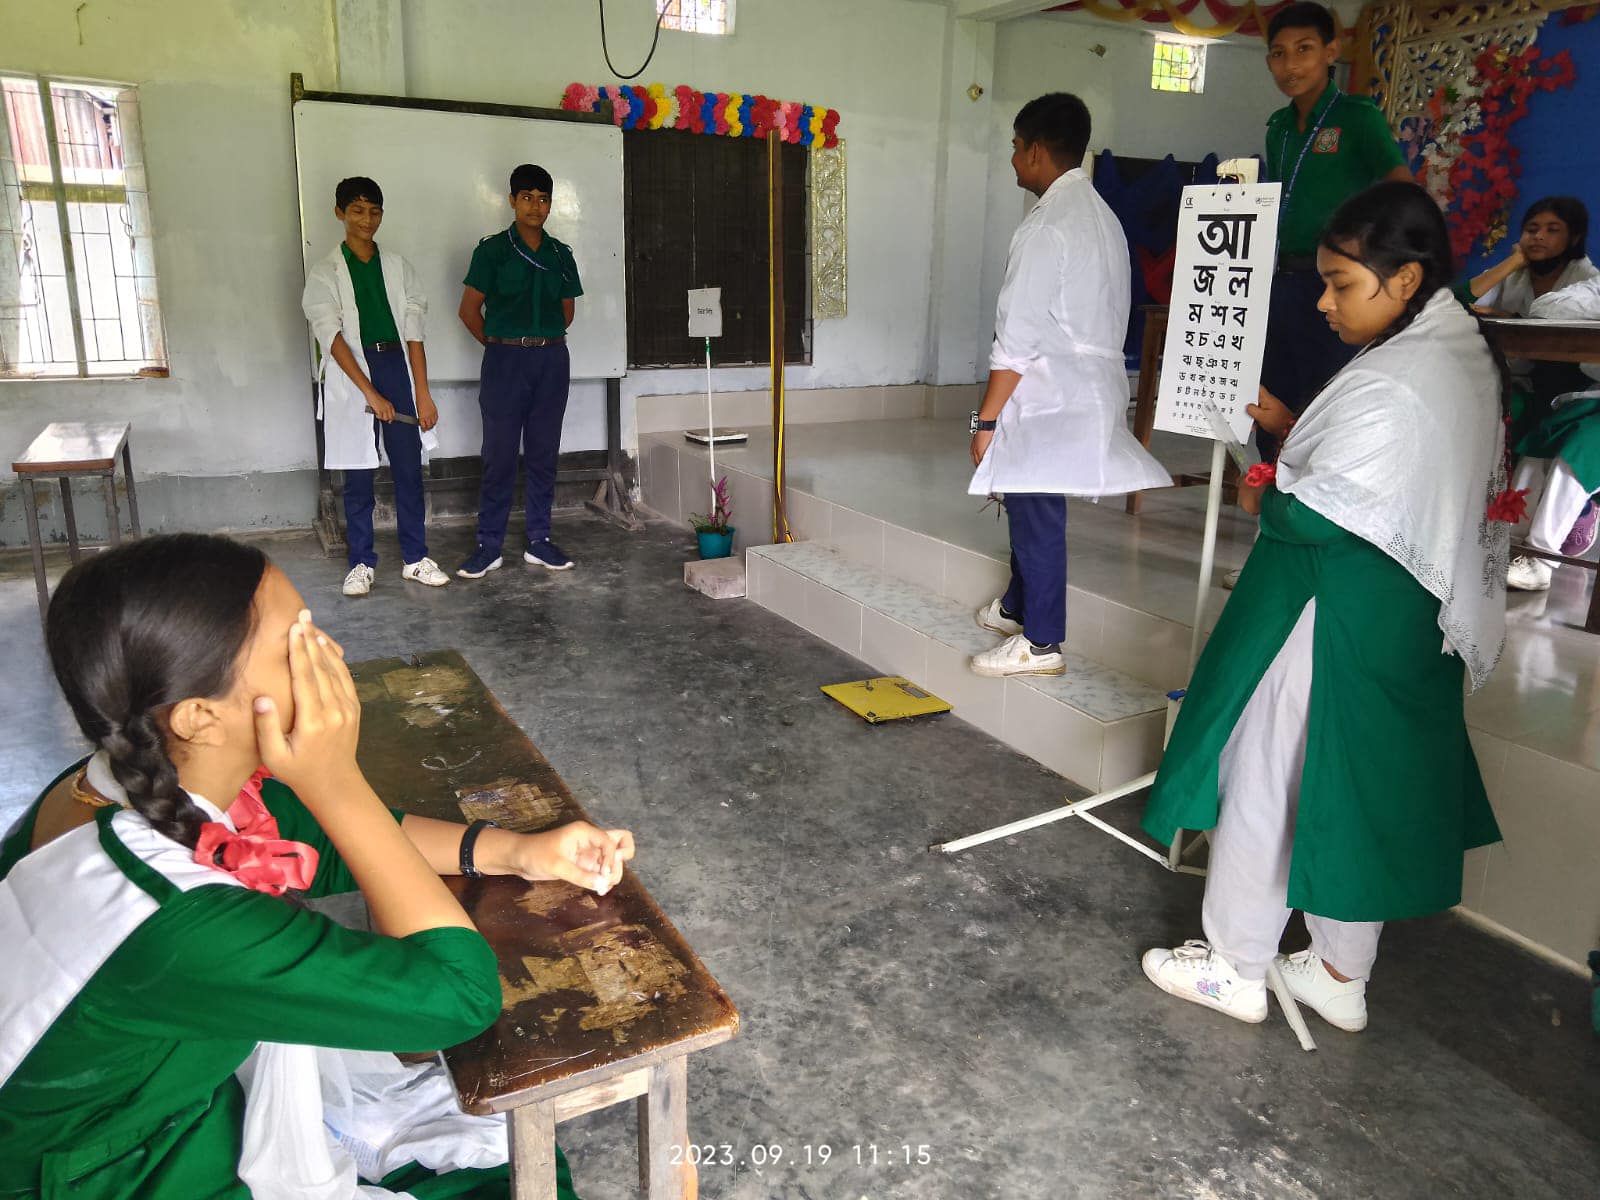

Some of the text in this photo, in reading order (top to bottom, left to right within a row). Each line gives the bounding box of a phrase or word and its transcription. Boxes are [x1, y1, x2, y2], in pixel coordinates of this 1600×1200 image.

[1197, 213, 1258, 260] আ
[1193, 265, 1253, 298] জ ল
[1188, 303, 1248, 328] ম শ ব
[1185, 330, 1245, 351] হ চ এ খ
